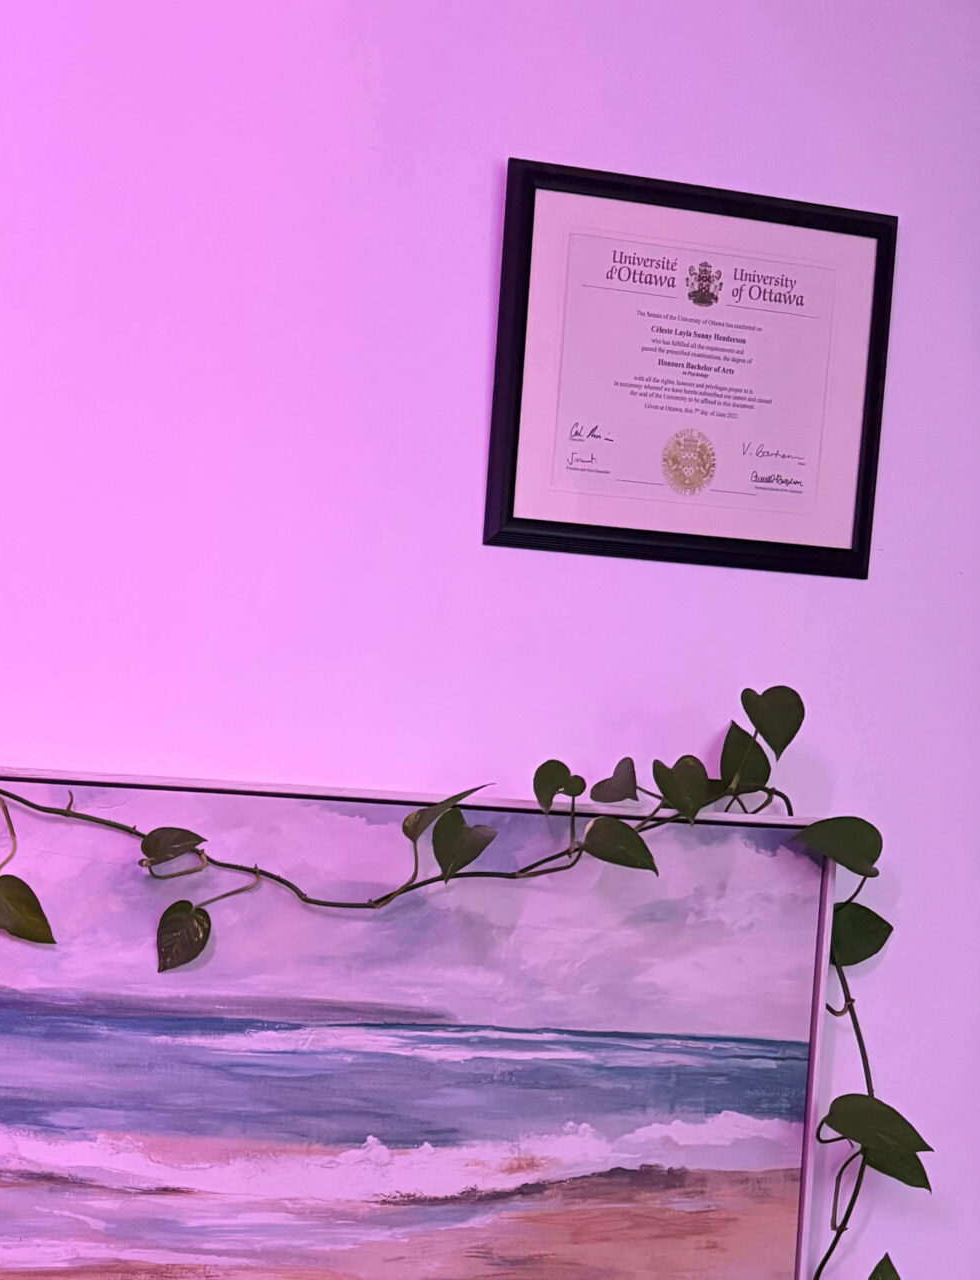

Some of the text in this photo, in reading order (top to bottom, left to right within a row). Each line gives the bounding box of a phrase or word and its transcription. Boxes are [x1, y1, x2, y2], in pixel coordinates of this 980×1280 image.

[612, 250, 678, 272] Université
[606, 265, 677, 289] d'Ottawa
[733, 267, 797, 293] University
[731, 283, 805, 307] of Ottawa
[674, 327, 692, 337] Layla
[713, 332, 746, 344] Henderson
[657, 358, 684, 368] Honours
[685, 361, 713, 372] Bachelor
[720, 366, 734, 374] Arts
